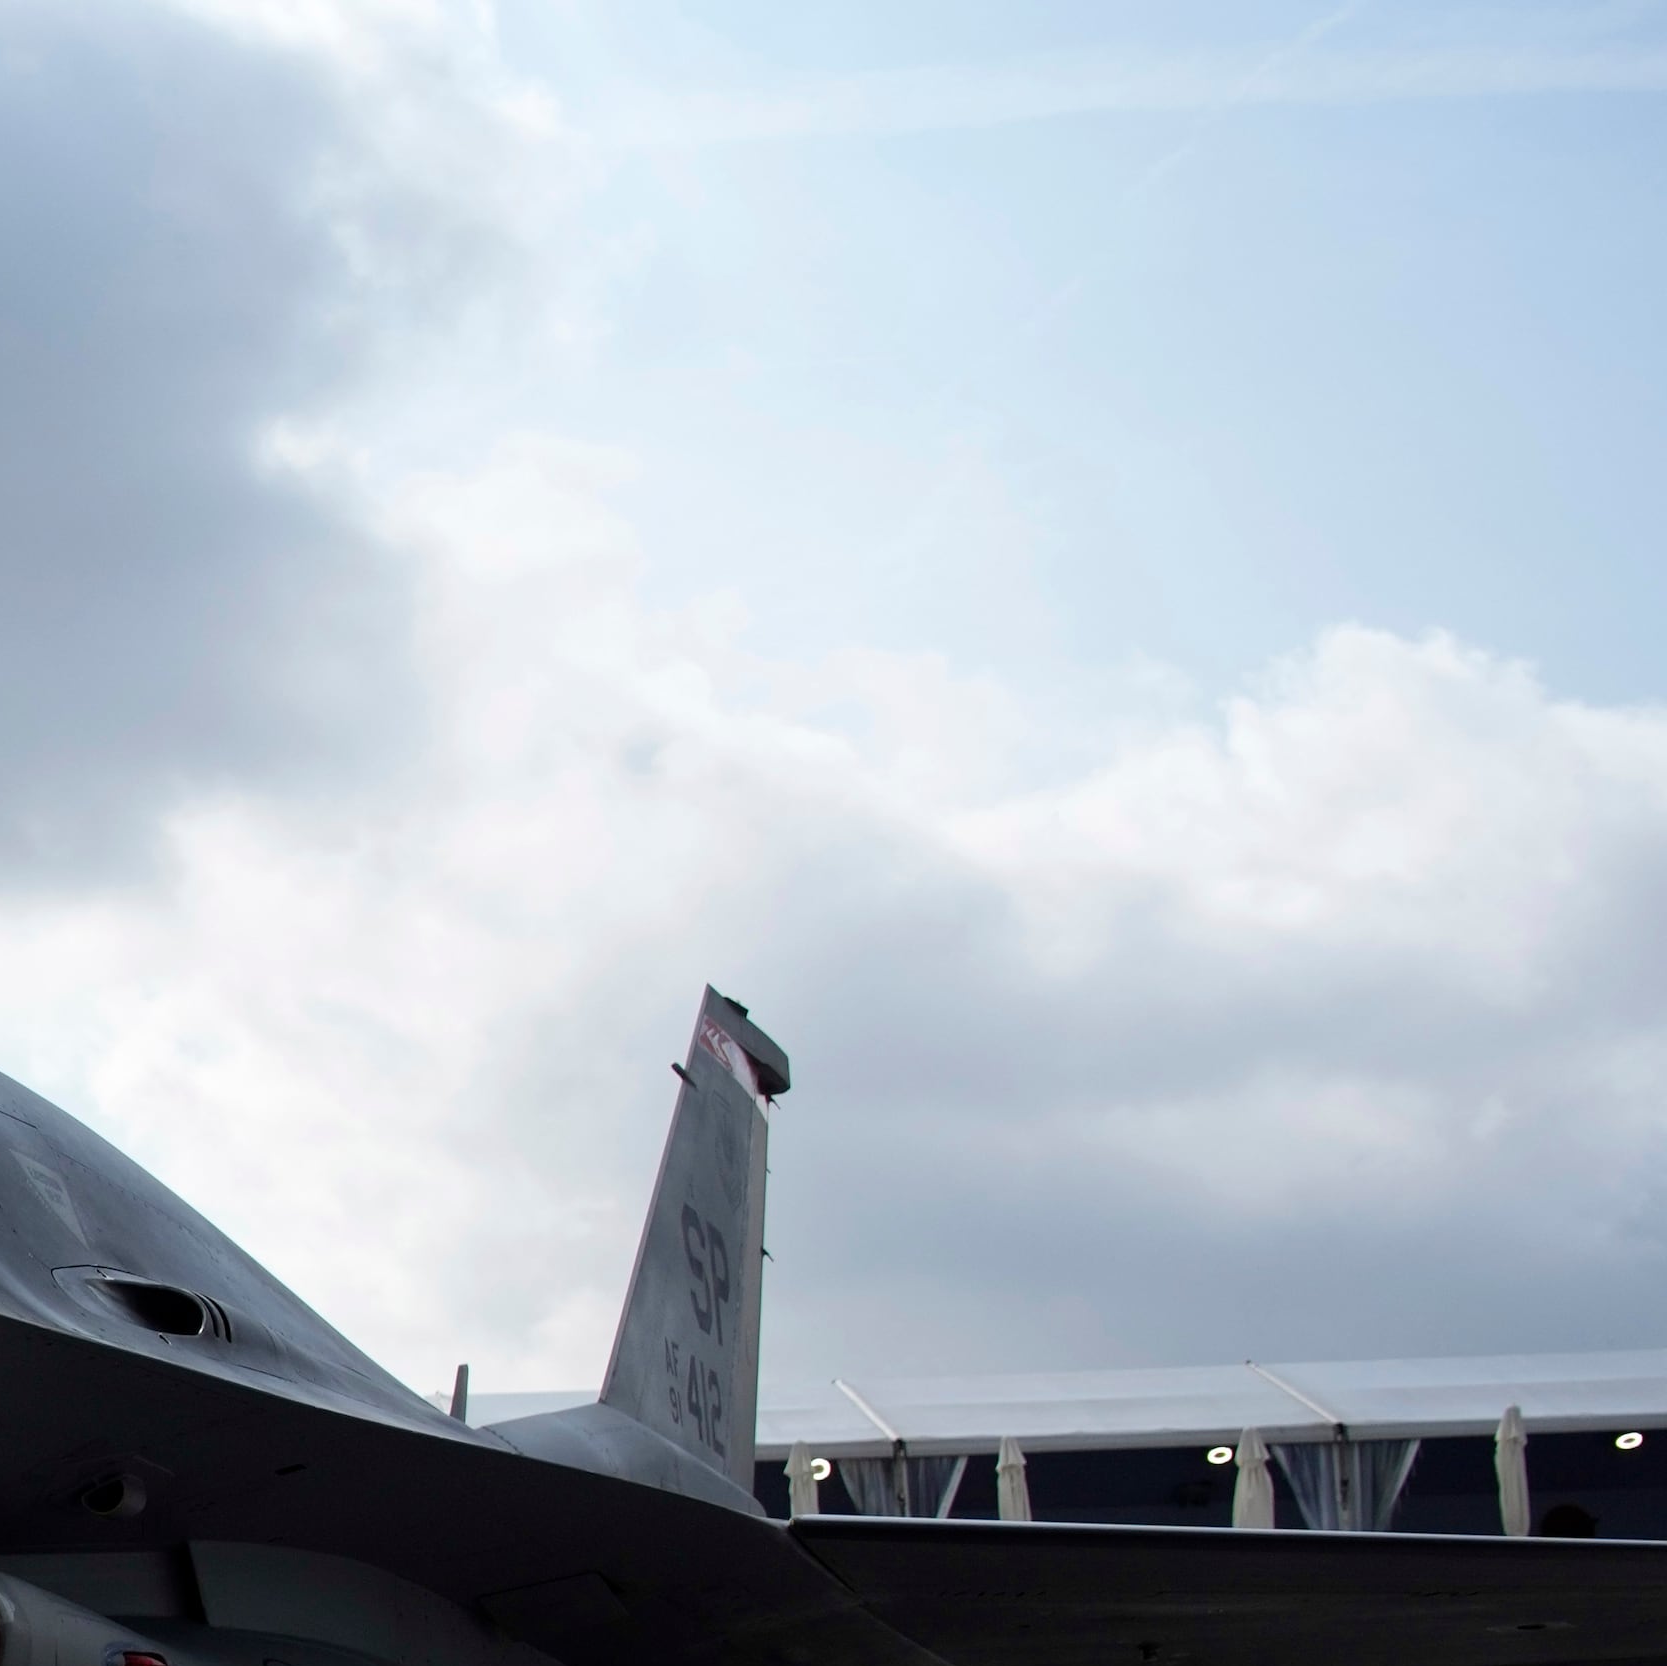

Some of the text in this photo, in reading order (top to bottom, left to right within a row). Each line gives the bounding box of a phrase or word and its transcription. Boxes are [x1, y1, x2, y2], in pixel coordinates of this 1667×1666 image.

[681, 1203, 729, 1347] SP
[665, 1336, 679, 1377] AF
[688, 1354, 725, 1460] 412
